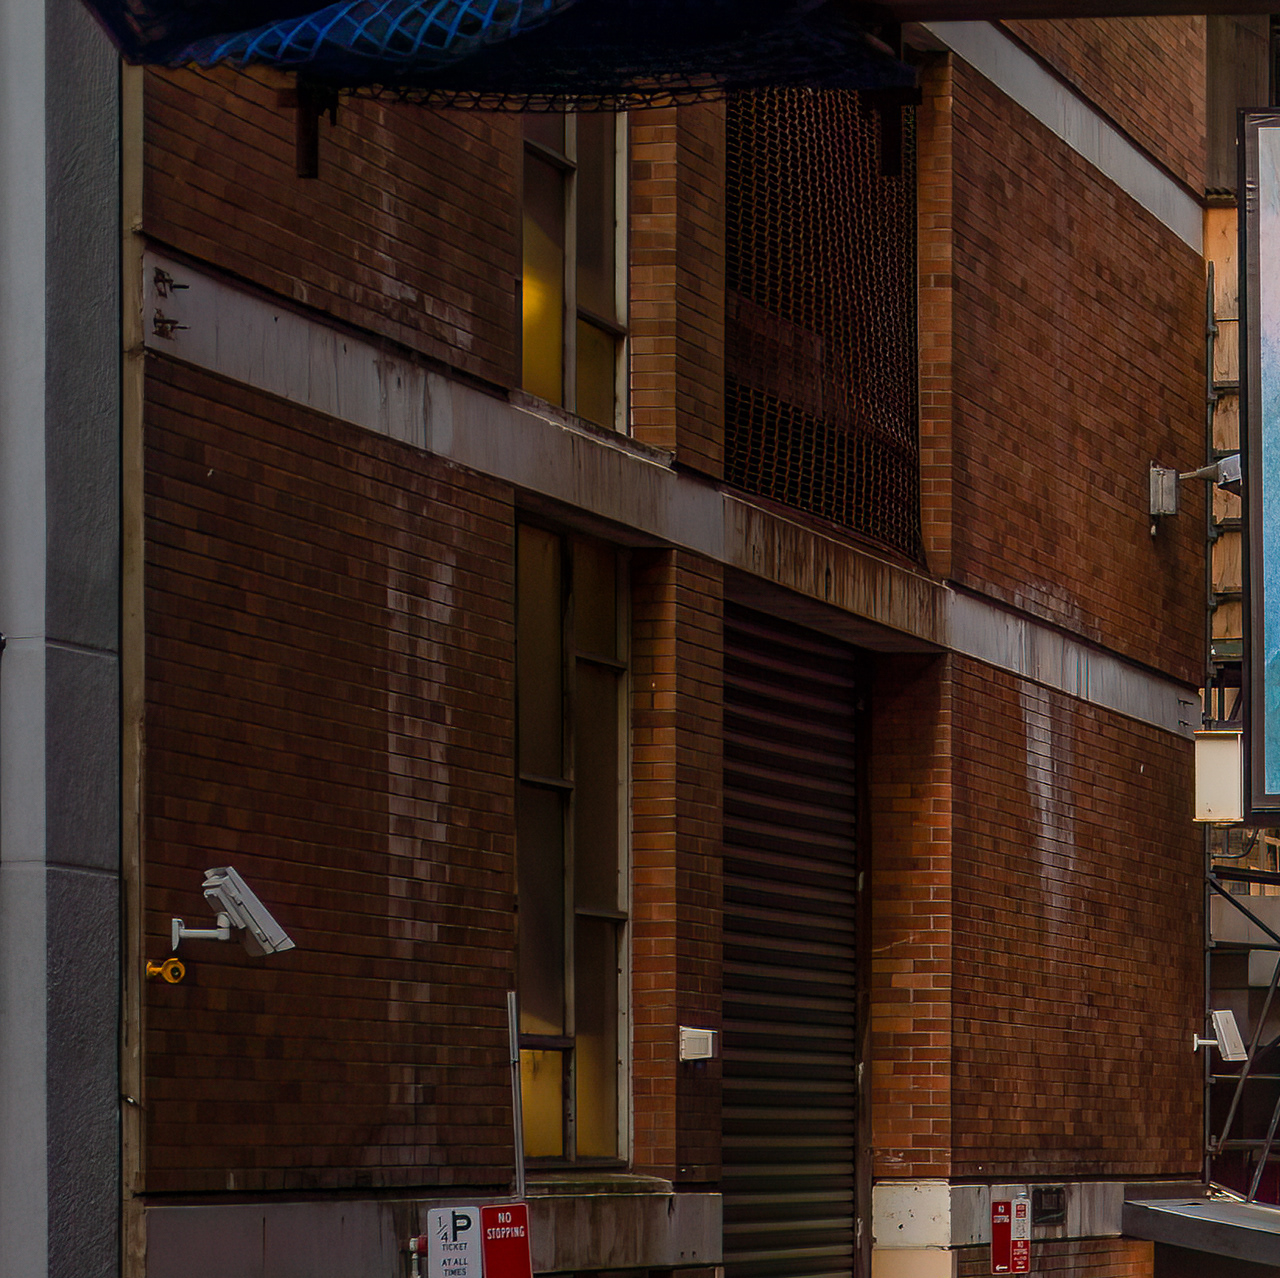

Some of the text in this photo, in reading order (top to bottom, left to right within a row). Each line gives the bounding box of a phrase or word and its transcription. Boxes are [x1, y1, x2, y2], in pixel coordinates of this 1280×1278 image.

[498, 1212, 512, 1224] NO
[487, 1226, 524, 1239] STOPPING
[442, 1243, 467, 1251] TICKET
[442, 1257, 468, 1267] AT ALL
[444, 1269, 466, 1277] TIMES
